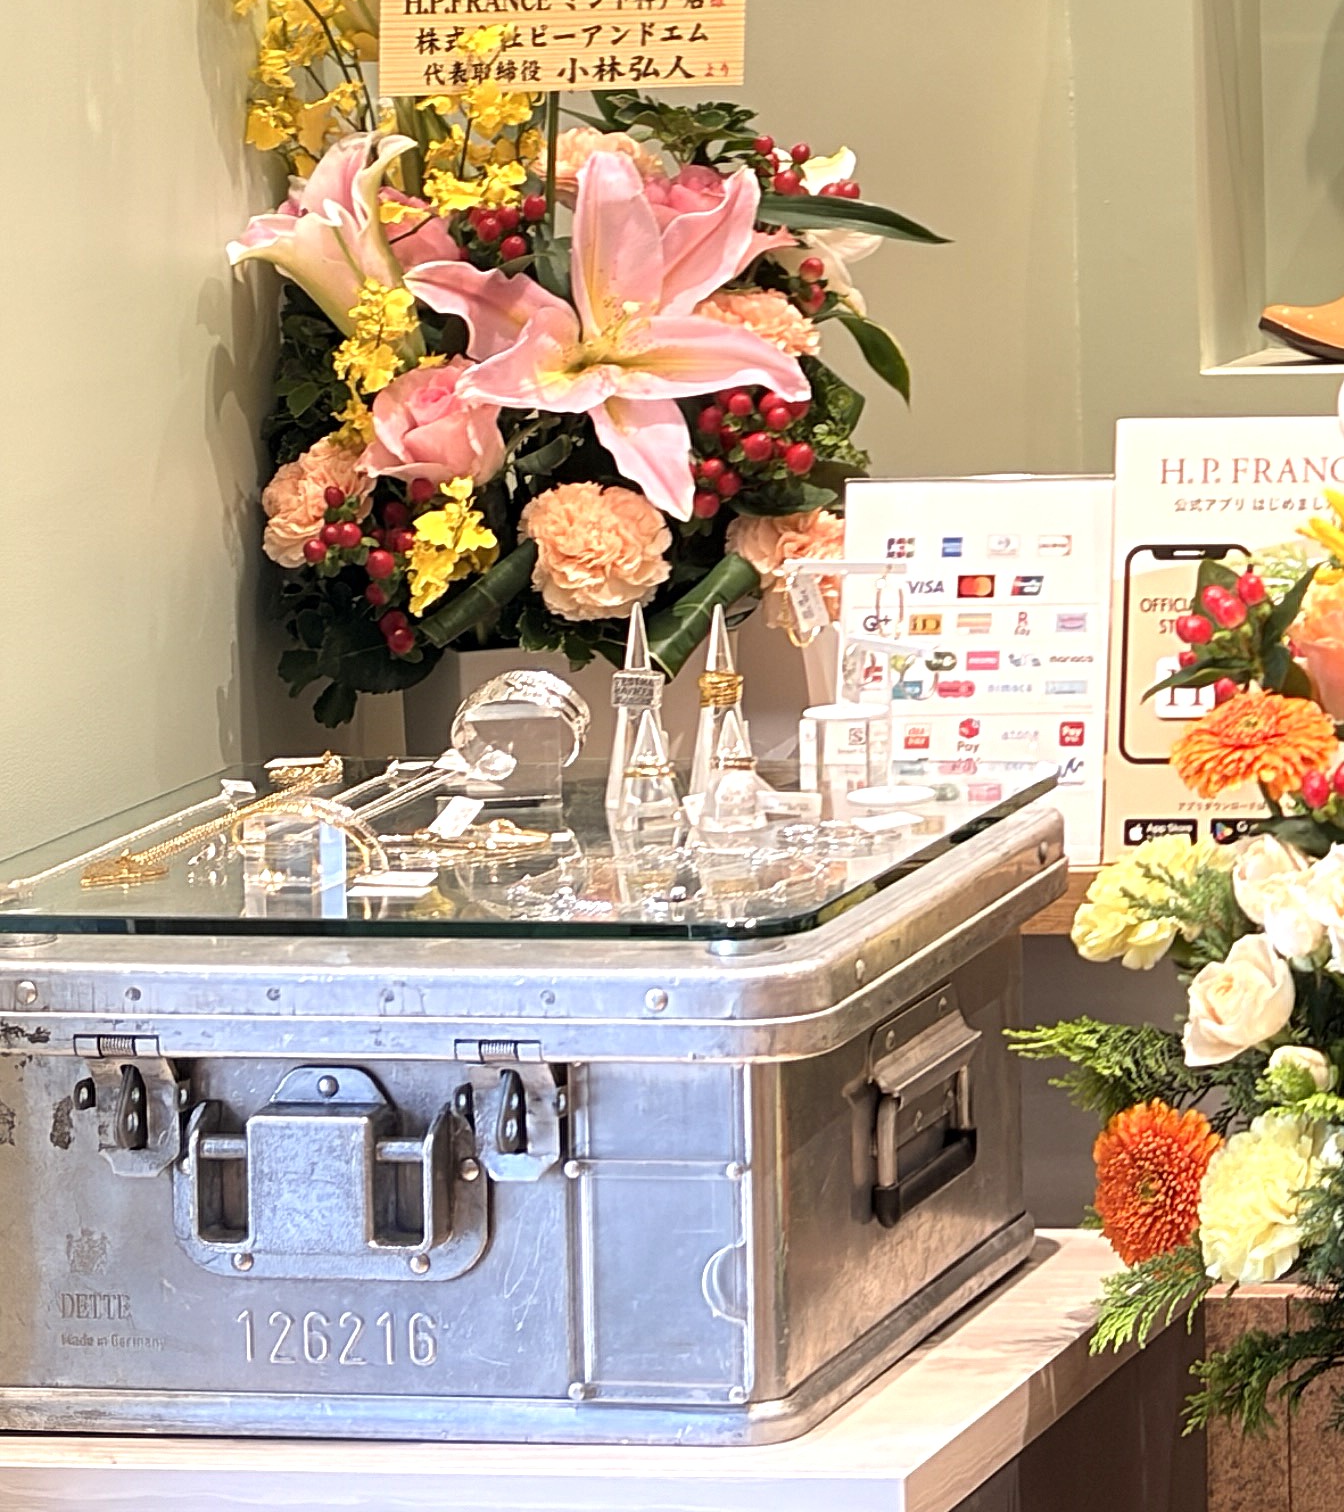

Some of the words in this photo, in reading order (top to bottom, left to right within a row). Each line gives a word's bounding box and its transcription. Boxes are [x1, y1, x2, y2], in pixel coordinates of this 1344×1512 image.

[556, 55, 695, 84] 小林弘人
[1174, 497, 1246, 513] 公式アプリ
[907, 580, 944, 594] VISA
[956, 740, 980, 754] Pay
[61, 1332, 95, 1347] Made
[111, 1333, 167, 1351] Germany
[234, 1309, 441, 1367] 126216
